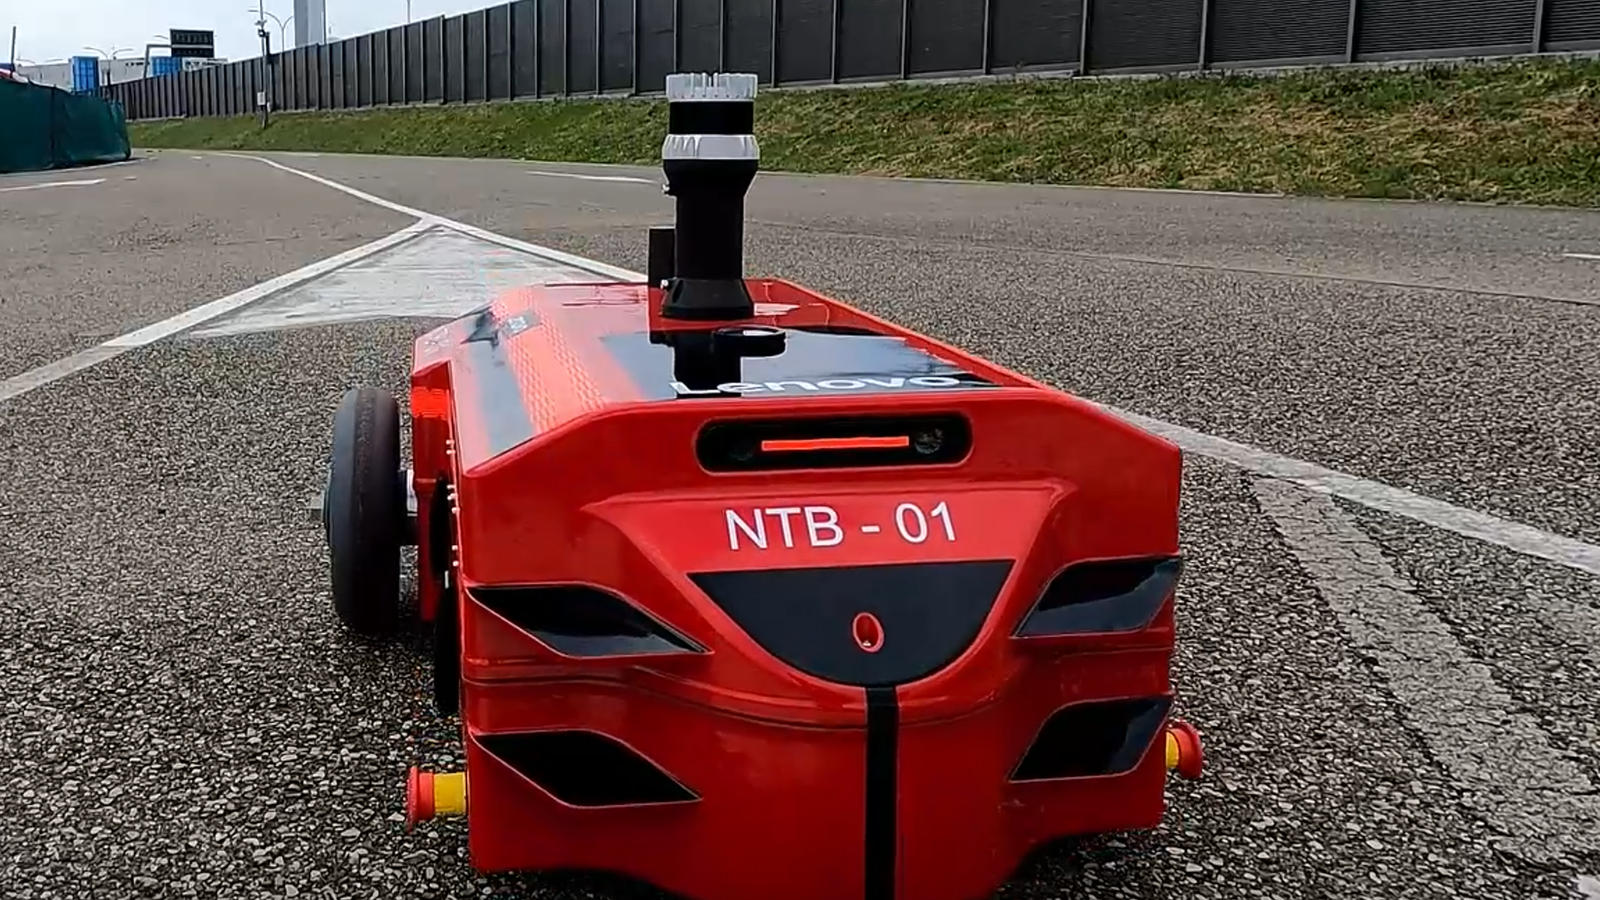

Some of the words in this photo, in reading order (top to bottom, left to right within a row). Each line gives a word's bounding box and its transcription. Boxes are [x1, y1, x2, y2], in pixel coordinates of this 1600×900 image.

[669, 376, 960, 395] Lenovo
[725, 507, 844, 550] NTB
[894, 502, 956, 543] 01
